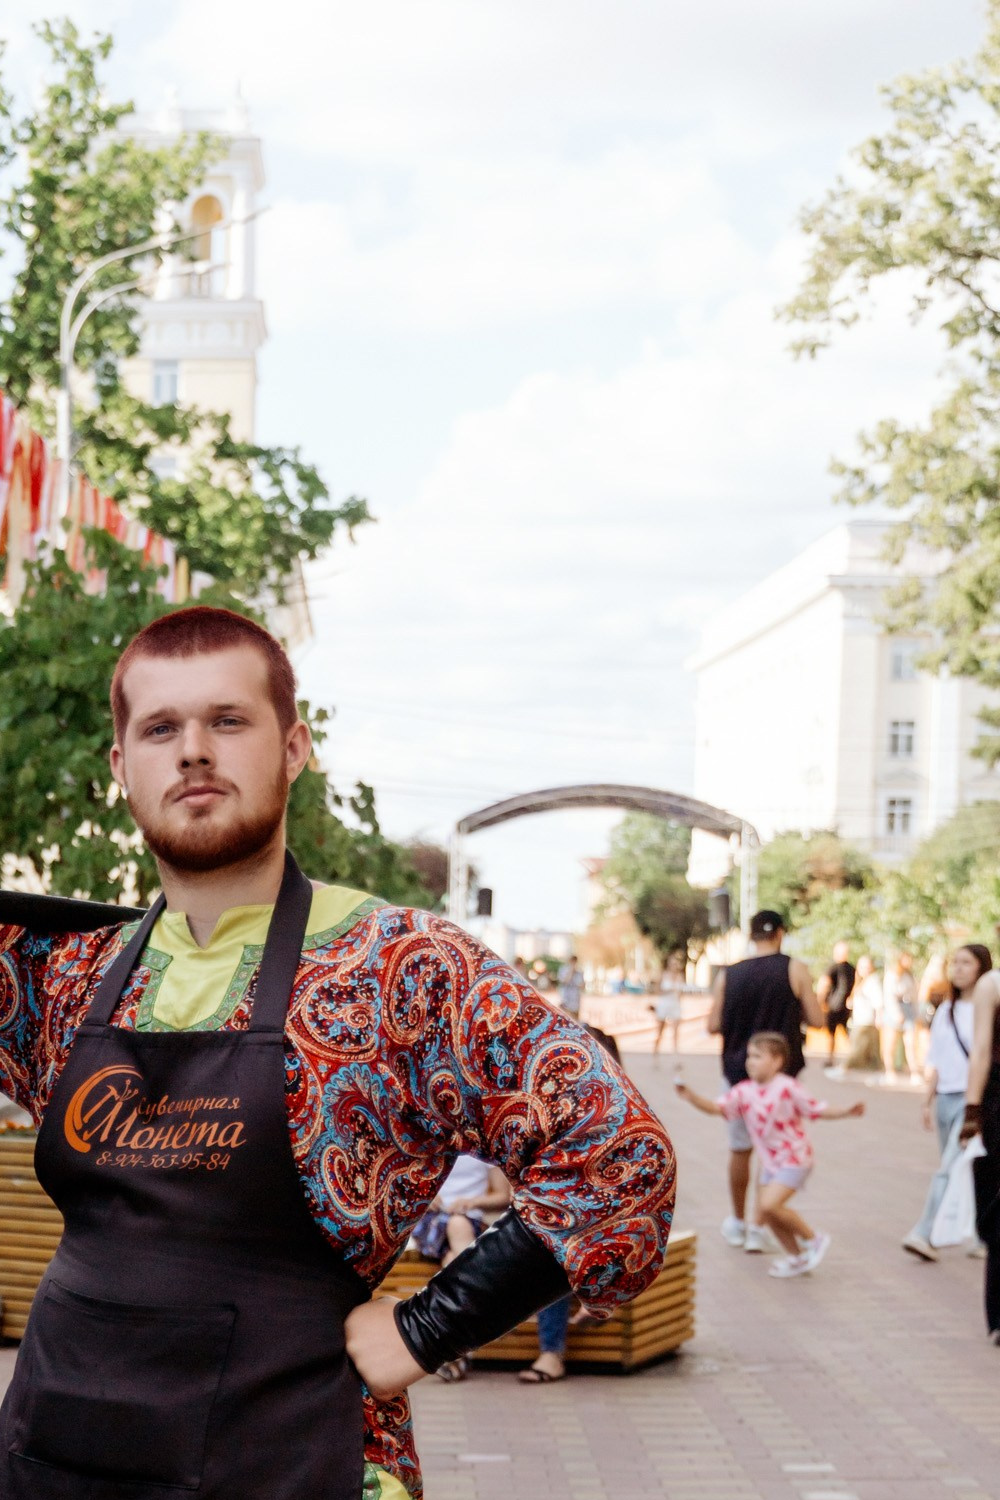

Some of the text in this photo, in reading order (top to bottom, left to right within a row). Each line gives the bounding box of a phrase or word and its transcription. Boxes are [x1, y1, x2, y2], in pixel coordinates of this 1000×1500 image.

[137, 1094, 240, 1125] Сувенирная
[83, 1101, 247, 1150] Монета
[96, 1151, 231, 1171] 8-904-363-95-84
